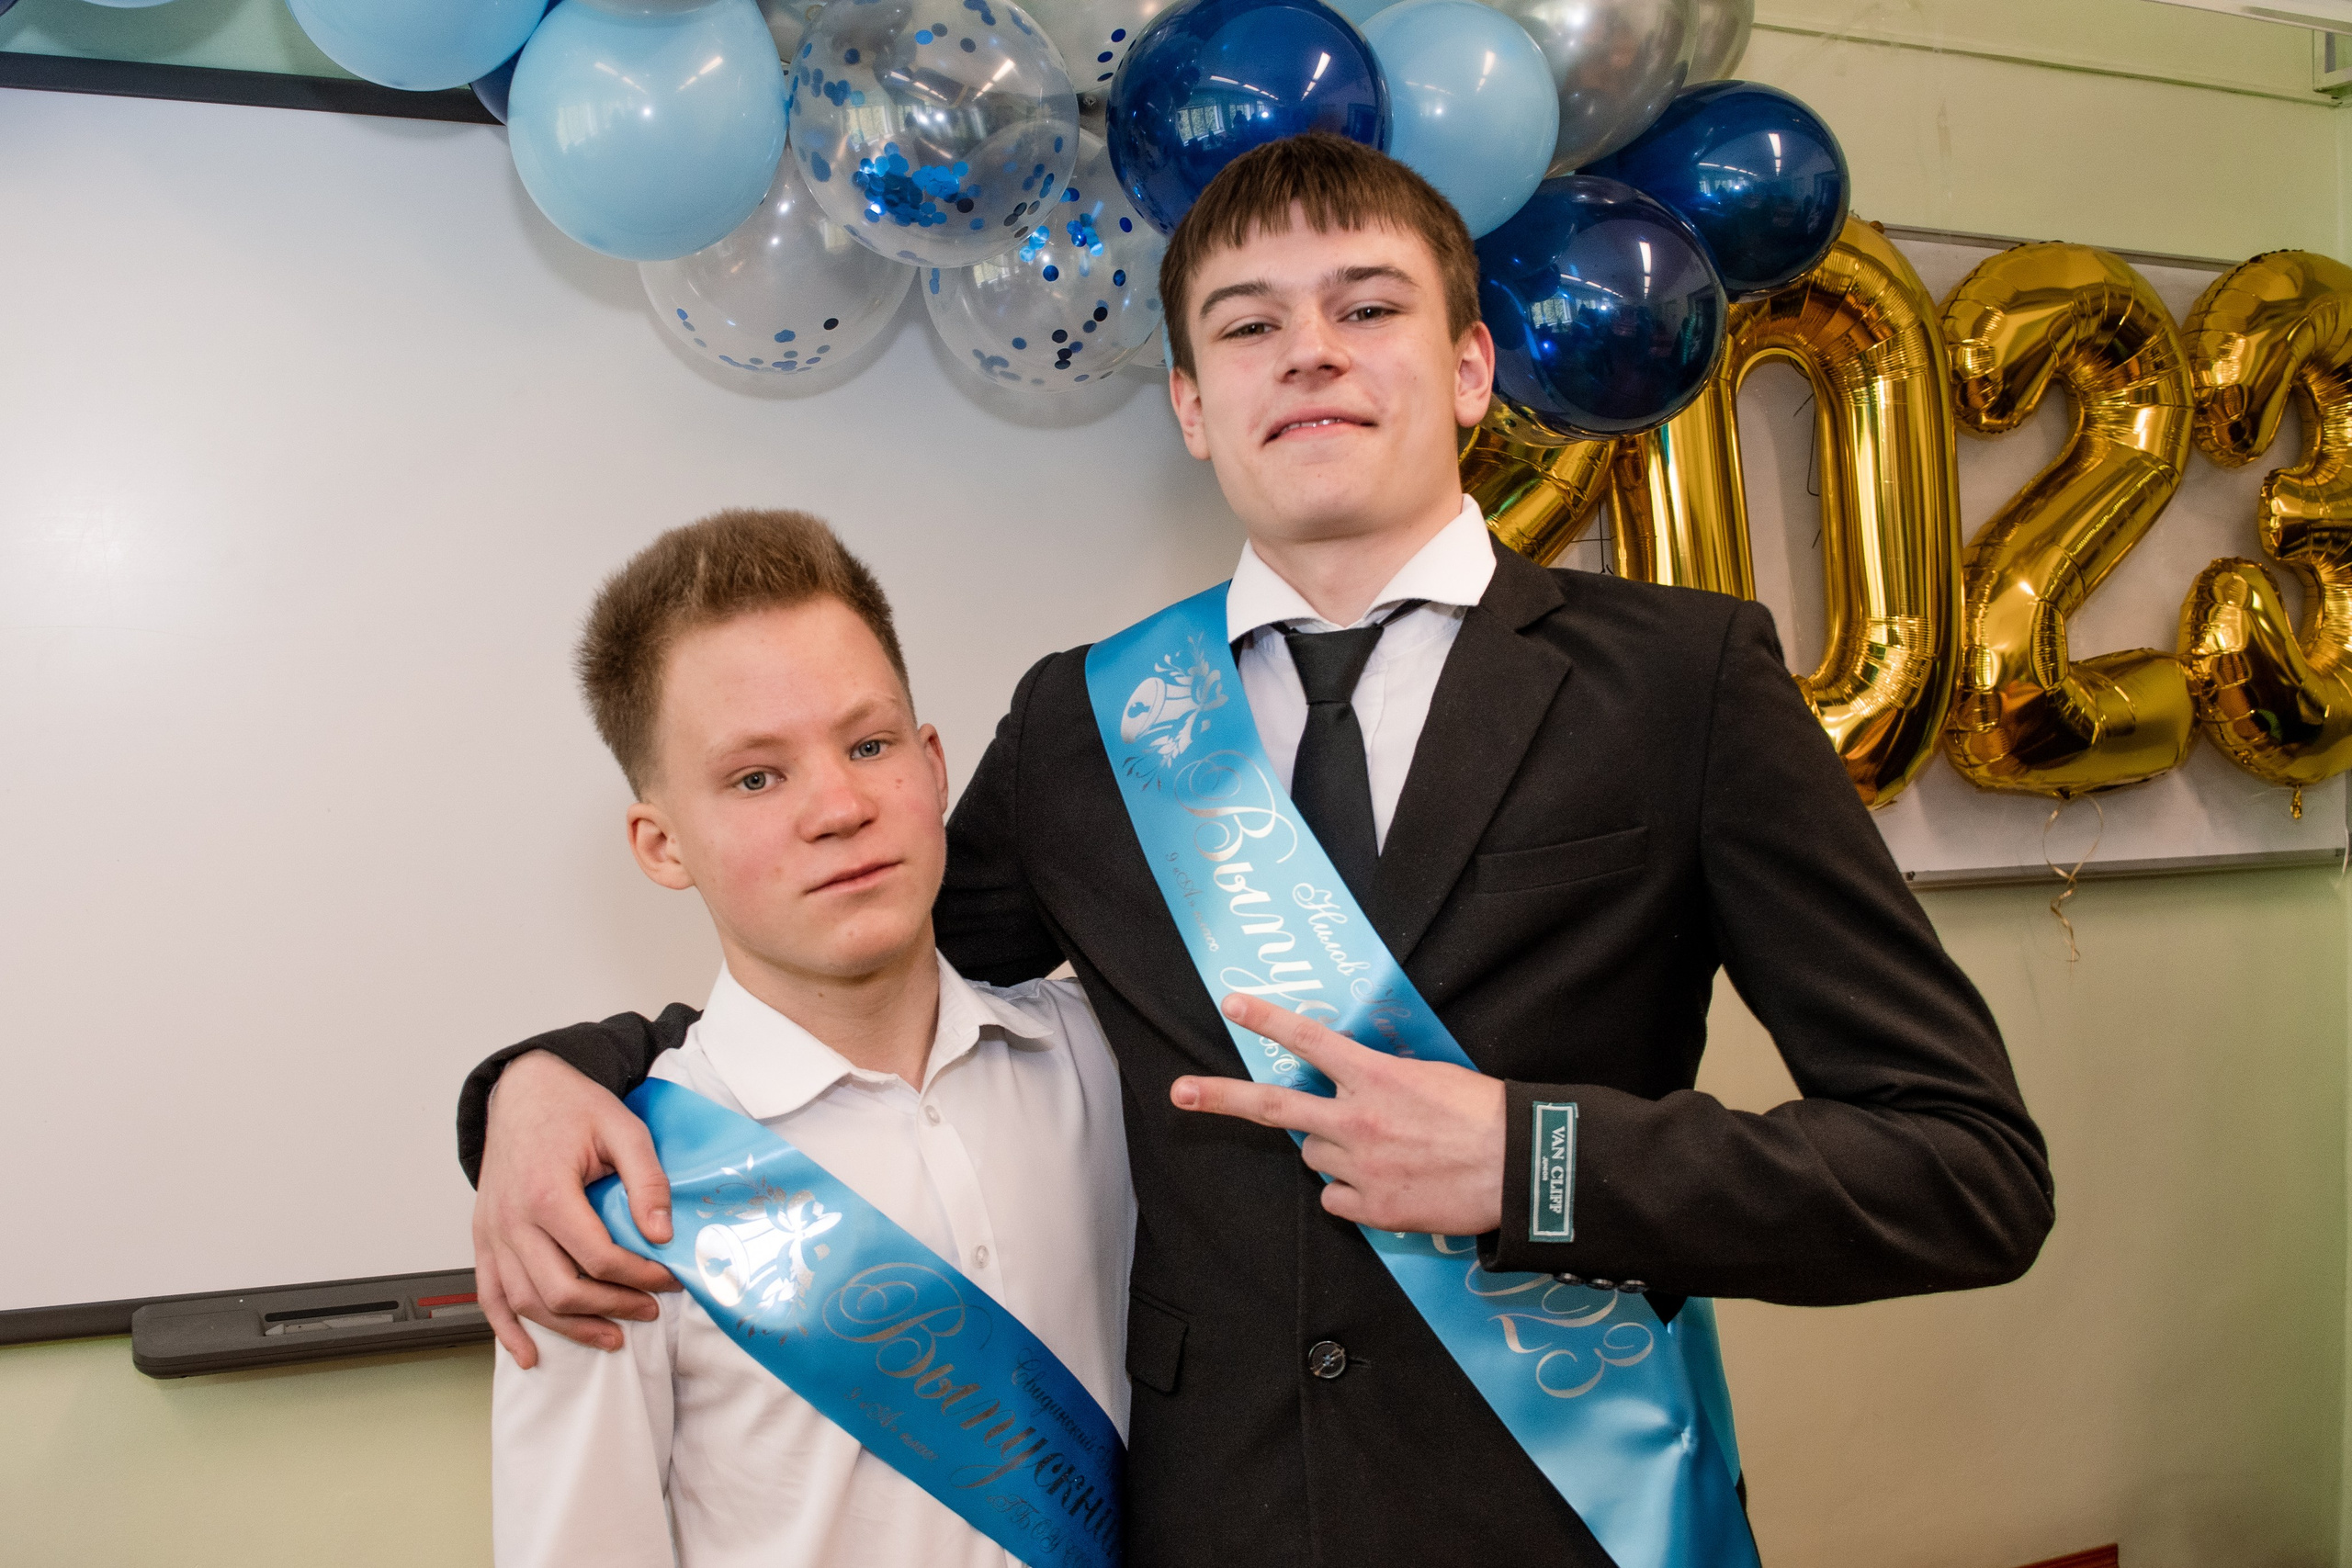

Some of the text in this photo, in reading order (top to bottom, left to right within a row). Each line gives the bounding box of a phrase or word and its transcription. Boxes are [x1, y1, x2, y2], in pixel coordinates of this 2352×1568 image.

[1293, 883, 1370, 977] Нилов
[1548, 1125, 1566, 1214] VAN CLIFF
